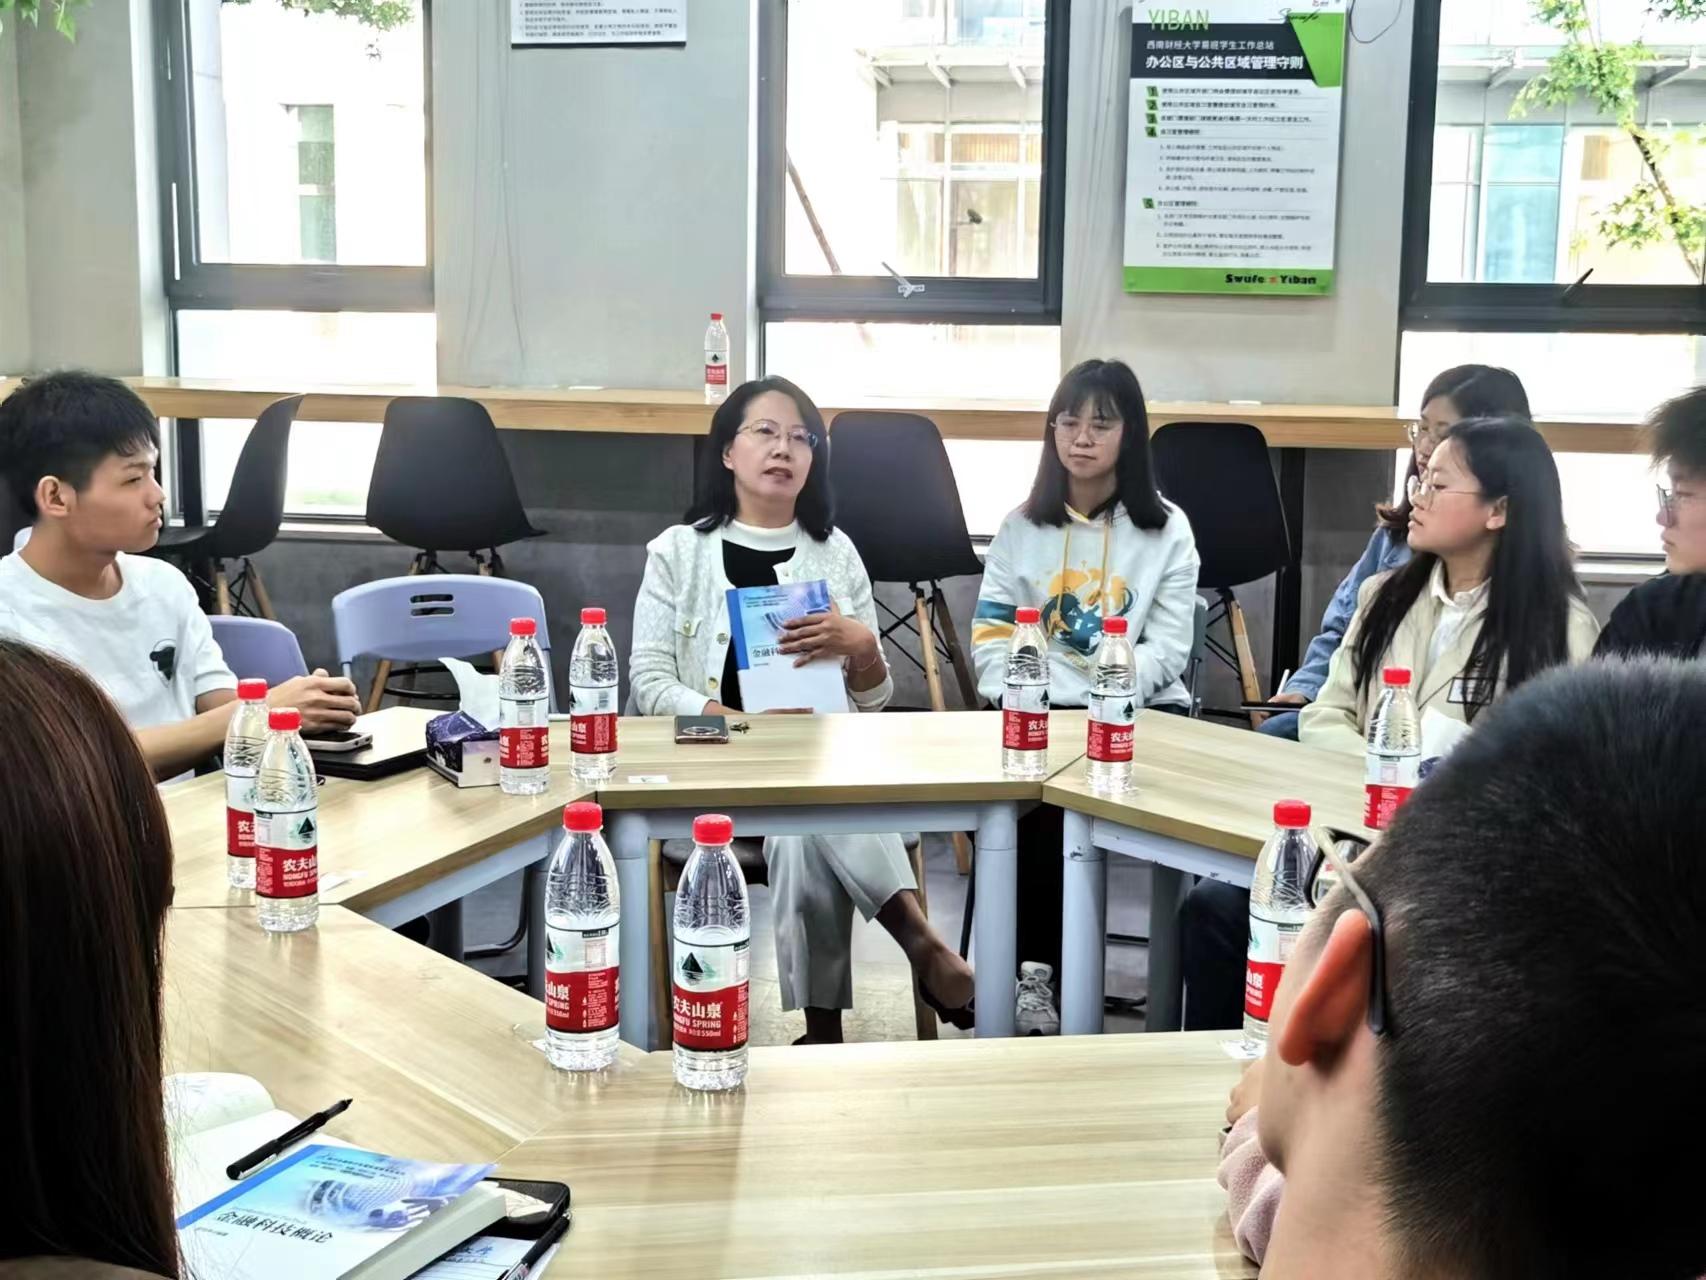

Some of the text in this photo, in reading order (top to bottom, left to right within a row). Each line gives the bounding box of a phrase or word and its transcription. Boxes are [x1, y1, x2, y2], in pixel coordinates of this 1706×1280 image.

[1148, 9, 1209, 30] YIBAN
[1145, 55, 1304, 70] 办公区与公共区域管理守则
[1225, 274, 1317, 285] Swufe Yiban
[692, 1019, 721, 1029] SPRING
[217, 1211, 333, 1243] 金融科技概论
